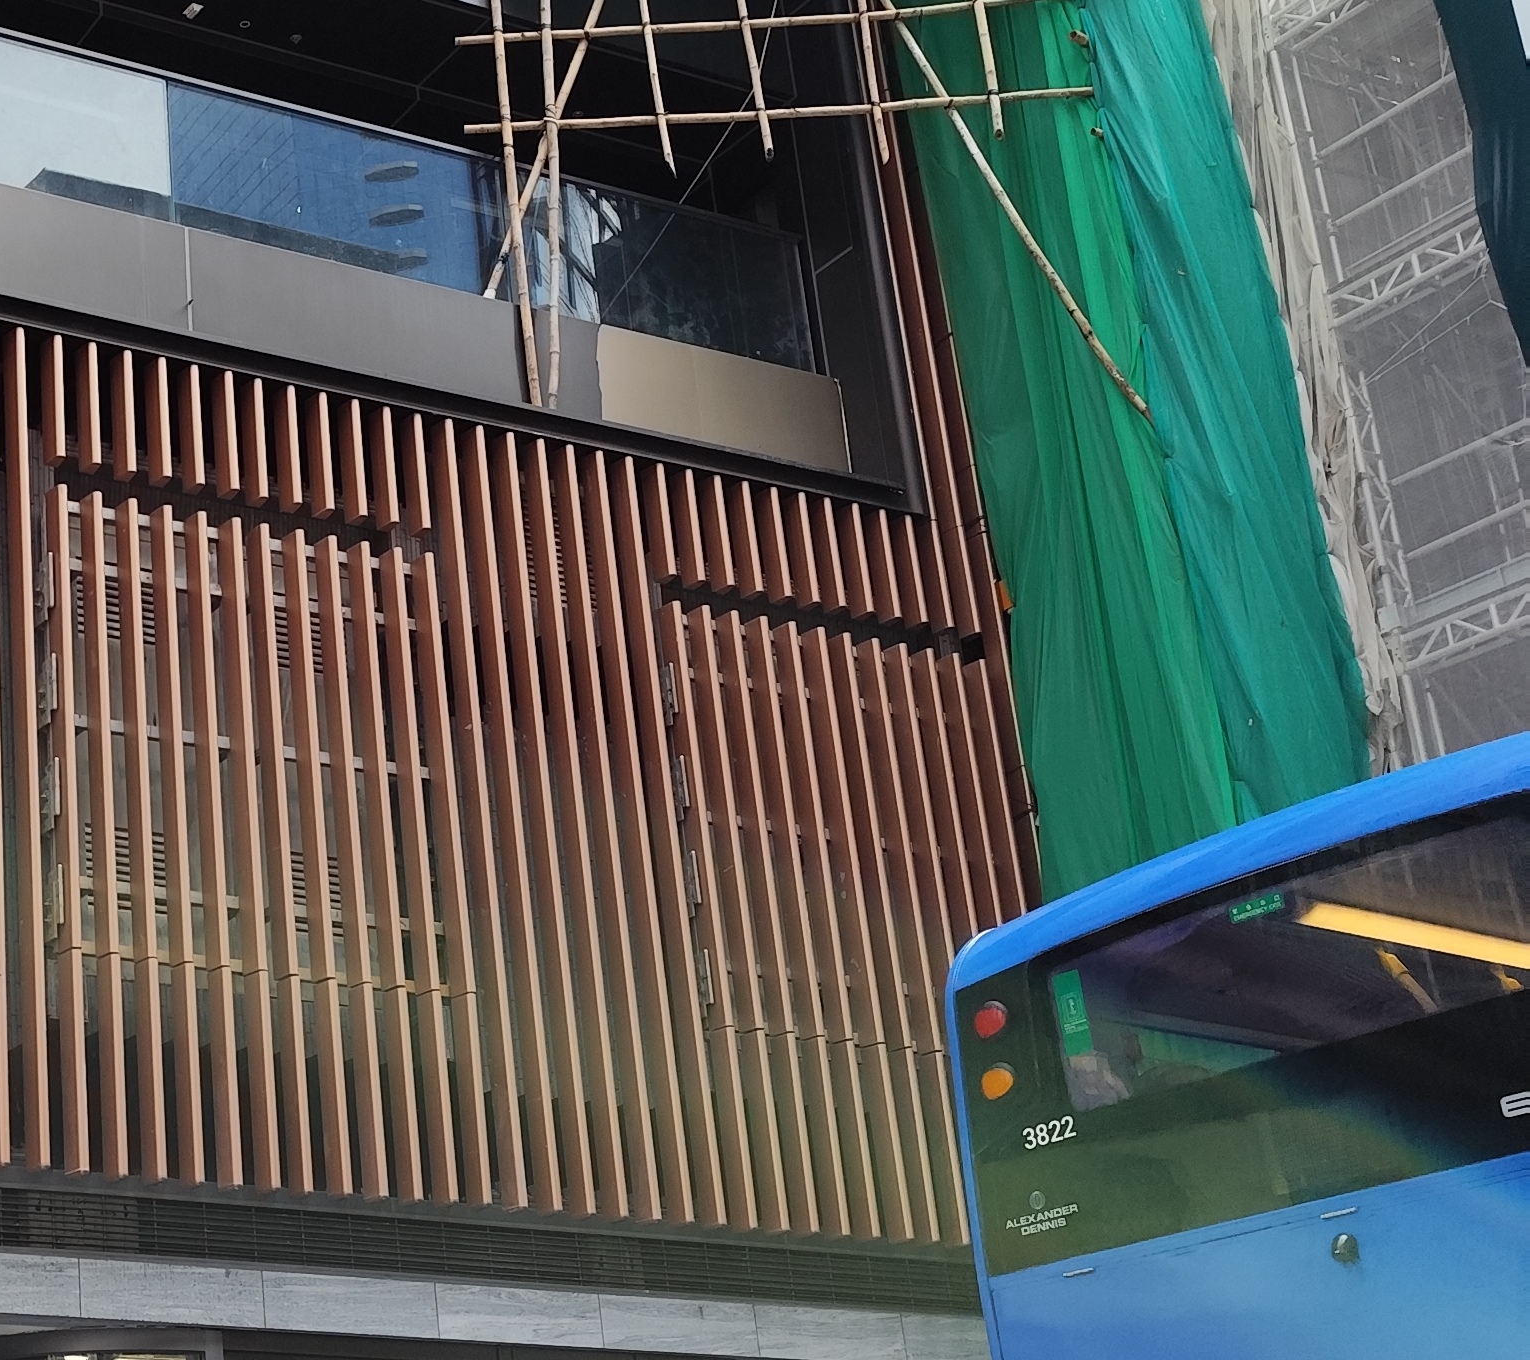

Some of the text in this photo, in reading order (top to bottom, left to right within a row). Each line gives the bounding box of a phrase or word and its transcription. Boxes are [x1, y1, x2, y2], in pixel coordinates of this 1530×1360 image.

[1022, 1115, 1077, 1150] 3822
[1005, 1203, 1079, 1230] ALEXANDER
[1021, 1217, 1067, 1236] DENNIS
